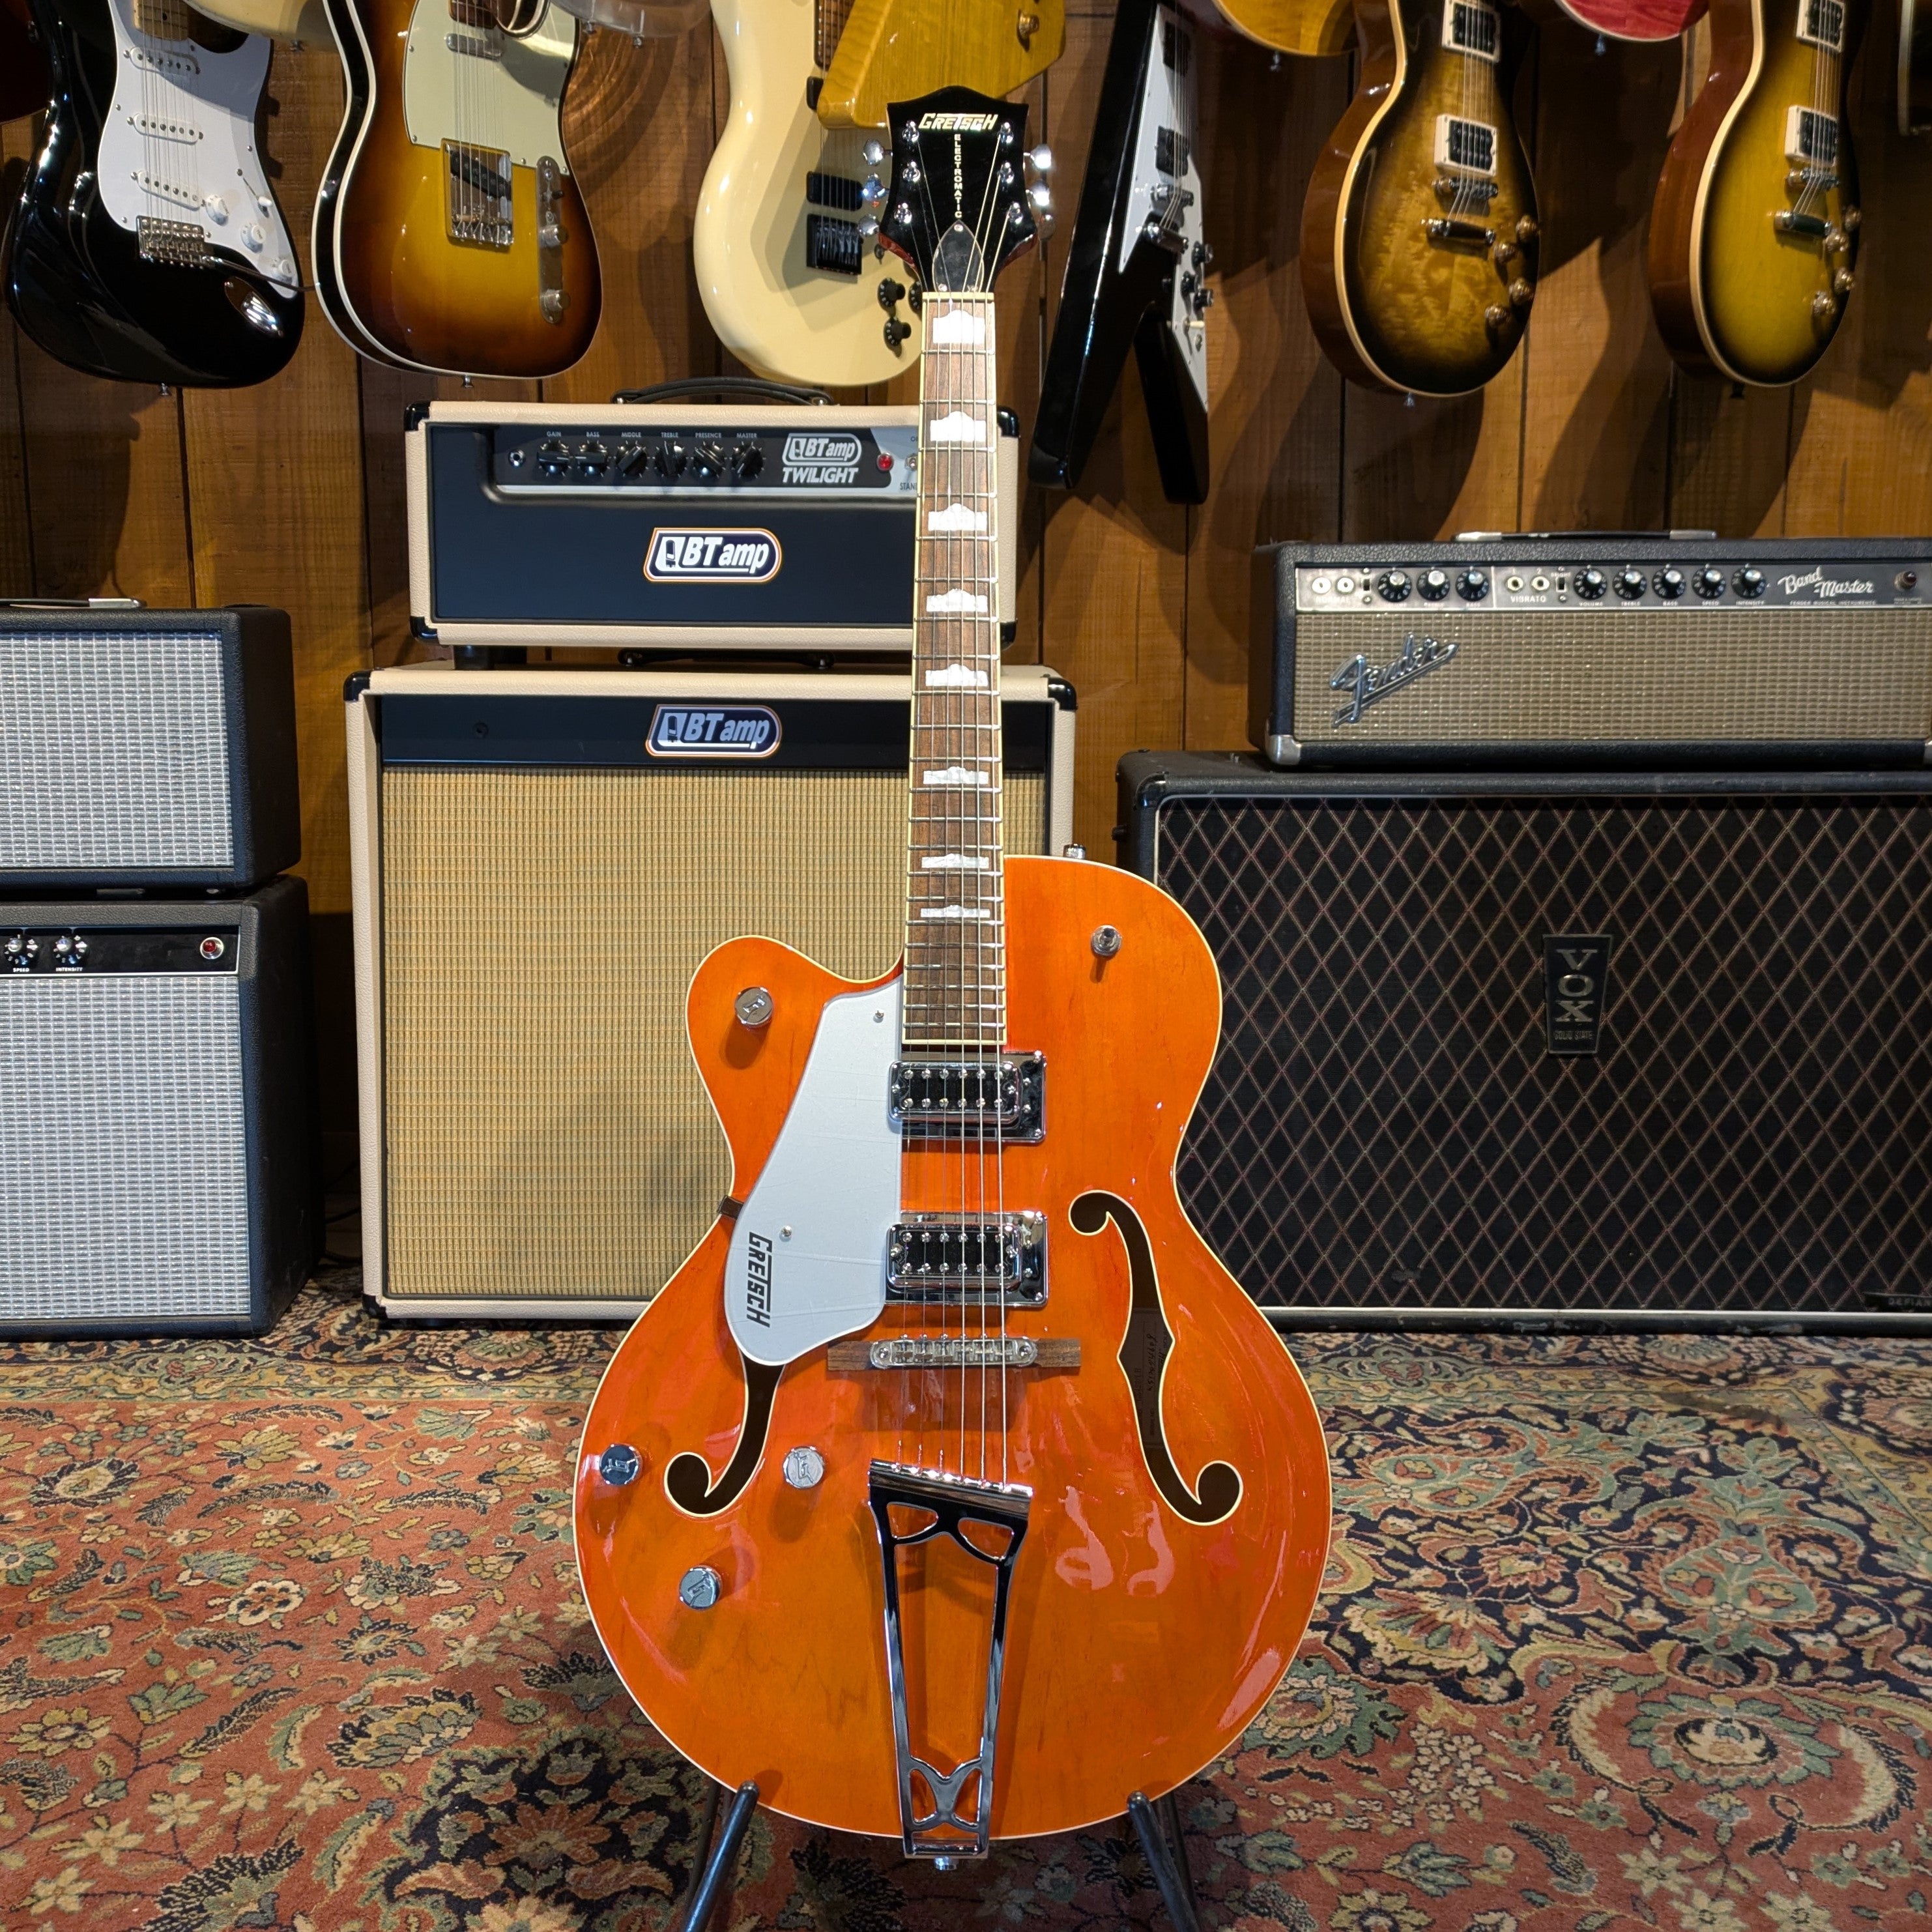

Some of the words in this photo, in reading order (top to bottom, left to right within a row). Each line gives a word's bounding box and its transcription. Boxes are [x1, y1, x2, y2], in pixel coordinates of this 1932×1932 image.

[918, 113, 999, 130] GRETSCH
[954, 134, 963, 219] ELECTROMATIC
[783, 467, 859, 483] TWILIGHT
[1778, 566, 1823, 595] Band
[1814, 579, 1875, 599] Master
[1330, 632, 1460, 728] Fender
[1555, 949, 1598, 1022] VOX
[746, 1232, 773, 1328] GRETSCH
